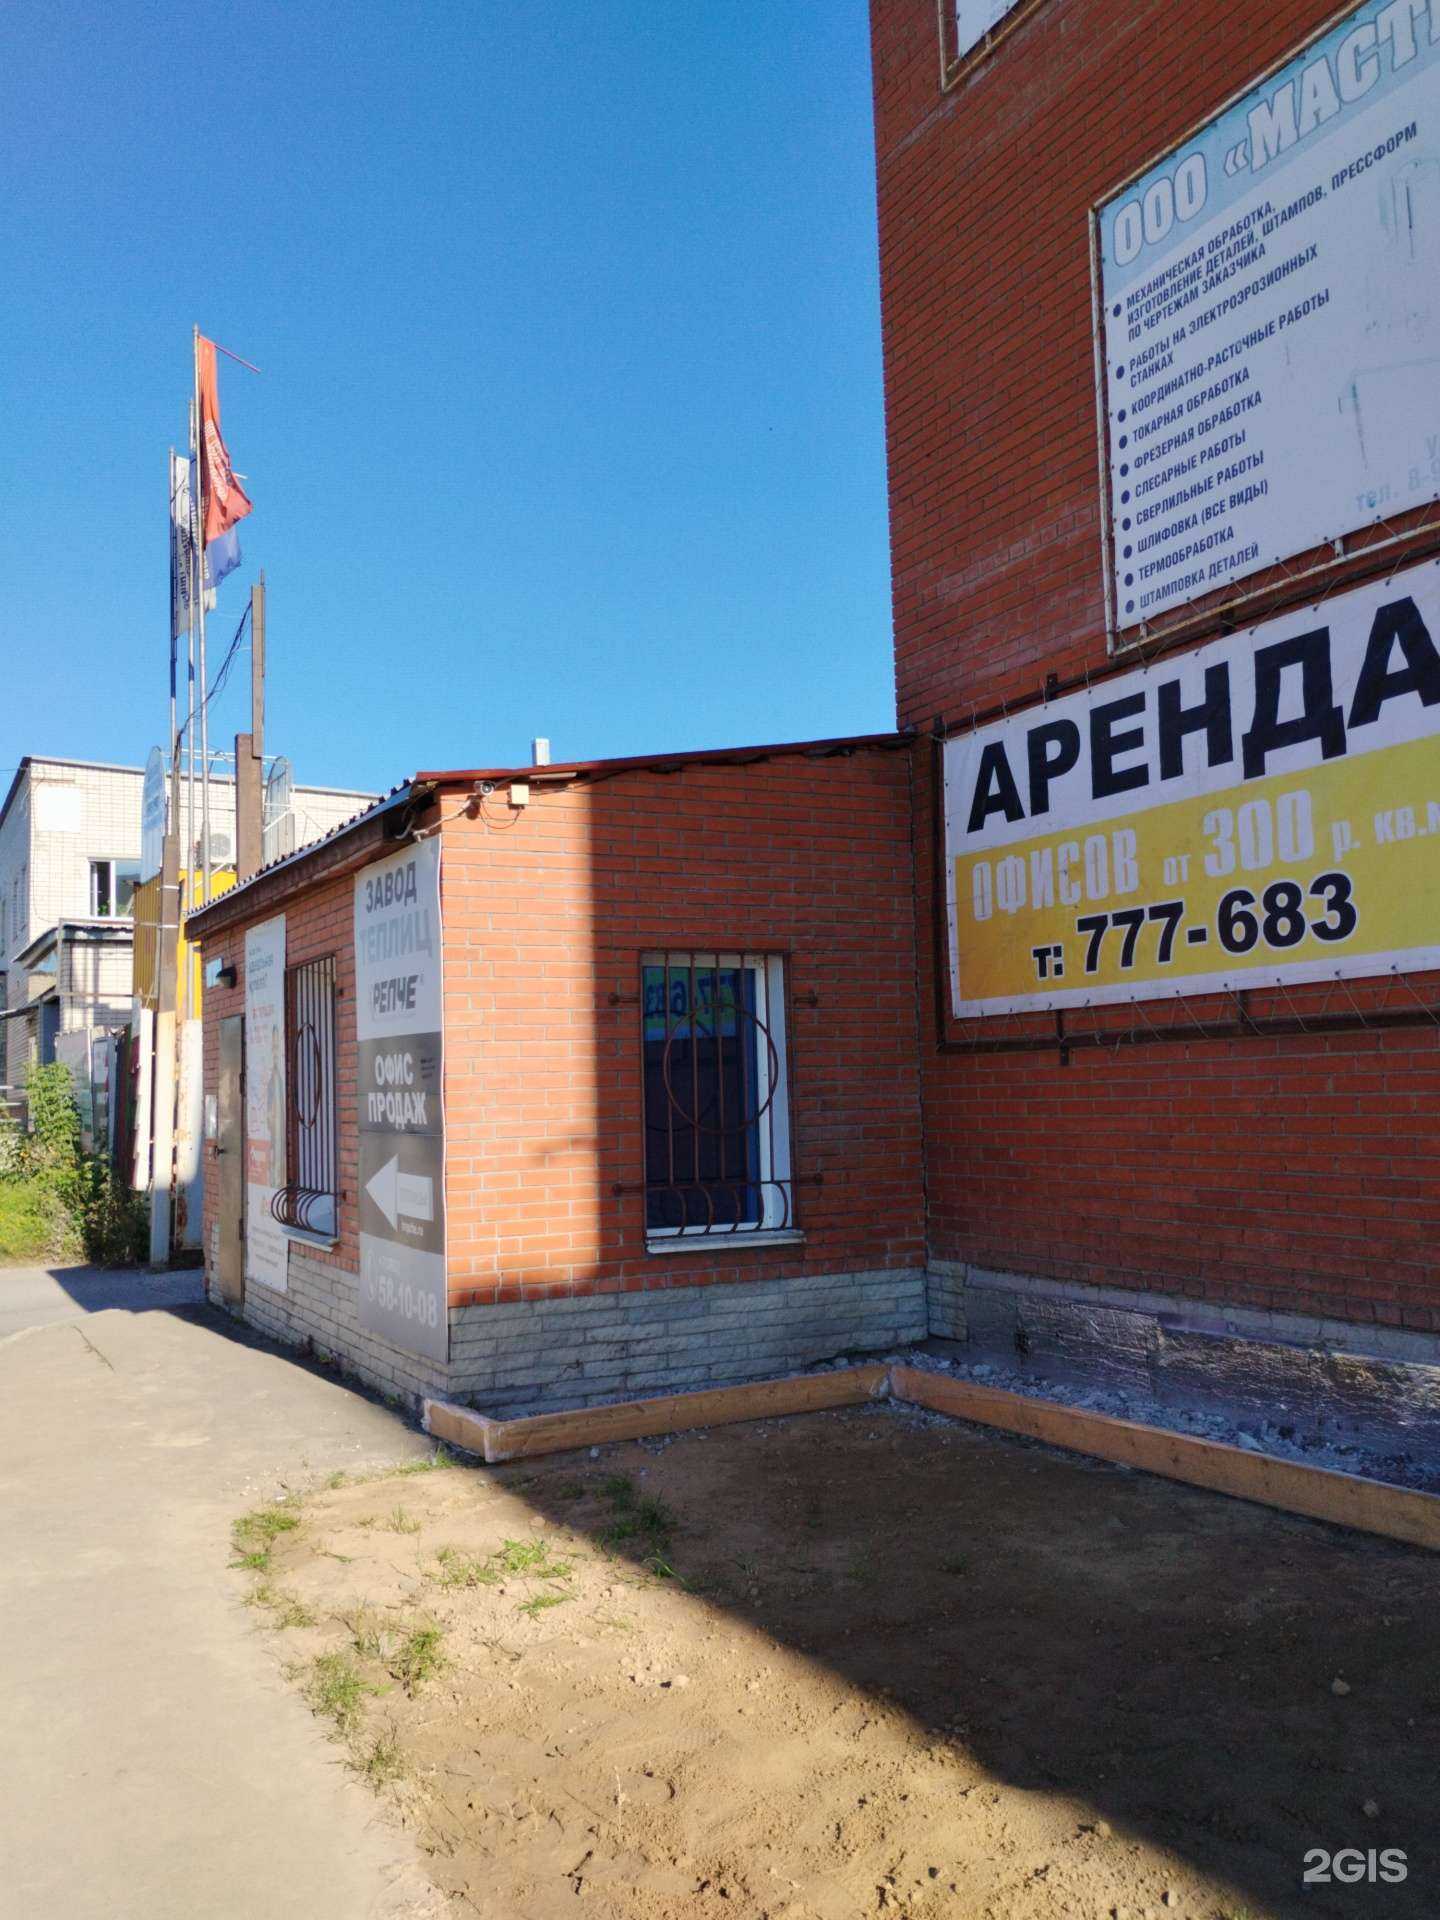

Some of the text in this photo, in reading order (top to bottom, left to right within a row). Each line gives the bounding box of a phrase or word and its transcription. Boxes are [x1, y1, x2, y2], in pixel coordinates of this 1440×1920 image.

[1113, 152, 1208, 267] ООО
[1127, 266, 1201, 325] ИЗГОТОВЛЕНИЕ
[1331, 121, 1417, 190] ПРЕССФОРМ
[1126, 246, 1204, 309] МЕХАНИЧЕСКАЯ
[1128, 243, 1266, 342] ПО ЧЕРТЕЖАМ ЗАКАЗЧИКА
[1129, 337, 1169, 371] РАБОТЫ
[1172, 327, 1186, 346] НА
[1130, 351, 1174, 388] СТАНКАХ
[1131, 288, 1329, 415] КООРДИНАТНО-РАСТОЧНЫЕ РАБОТЫ
[1133, 366, 1249, 442] ТОКАРНАЯ ОБРАБОТКА
[1134, 391, 1262, 468] ФРЕЗЕРНАЯ ОБРАБОТКА
[1135, 429, 1246, 497] СЛЕСАРНЫЕ РАБОТЫ
[1136, 450, 1264, 525] СВЕРЛИЛЬНЫЕ РАБОТЫ
[1138, 479, 1268, 553] ШЛИФОВКА (ВСЕ ВИДЫ)
[1139, 526, 1234, 580] ТЕРМООБРАБОТКА
[1140, 542, 1259, 609] ШТАМПОВКА ДЕТАЛЕЙ
[966, 596, 1440, 833] АРЕНДА
[366, 861, 417, 913] ЗАВОД
[972, 827, 1140, 921] ОФИСОВ
[1203, 790, 1315, 878] 300
[1077, 872, 1358, 975] 777-683
[375, 1052, 414, 1085] ОФИС
[368, 1091, 427, 1129] ПРОДАЖ
